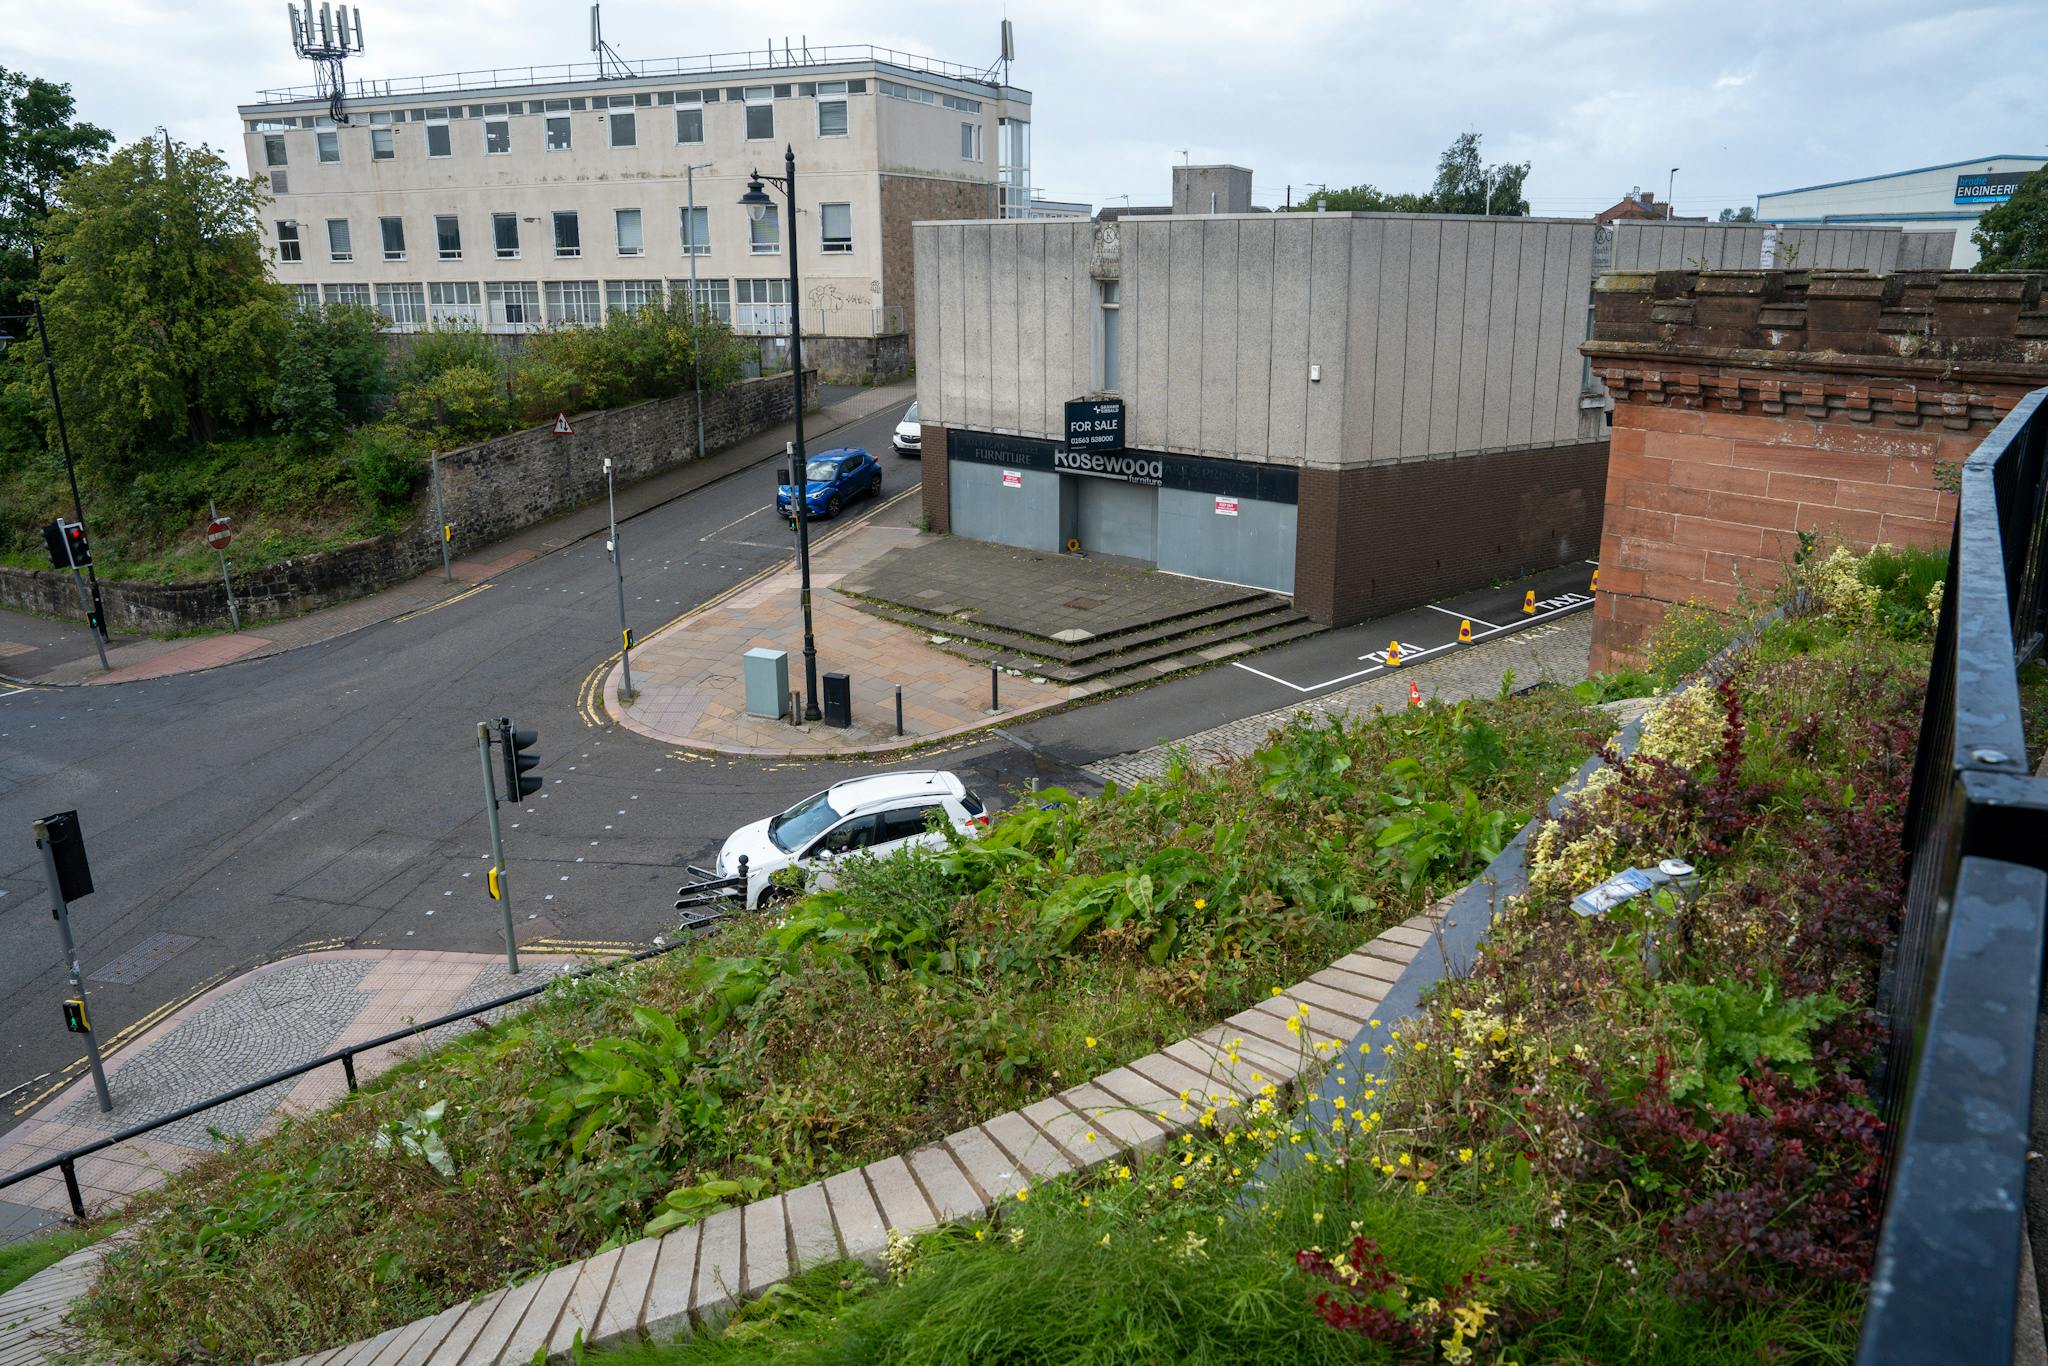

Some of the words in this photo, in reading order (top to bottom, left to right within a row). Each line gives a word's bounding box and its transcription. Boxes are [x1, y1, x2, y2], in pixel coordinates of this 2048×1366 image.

[1957, 184, 2018, 196] ENGINEERI
[1071, 421, 1091, 432] FOR
[1094, 420, 1118, 430] SALE
[1070, 436, 1090, 444] 01563
[1090, 435, 1114, 443] 528000
[975, 448, 1032, 465] FURNITURE
[1054, 448, 1163, 478] Rosewood
[1129, 474, 1163, 486] furniture
[1534, 593, 1590, 610] TAXI
